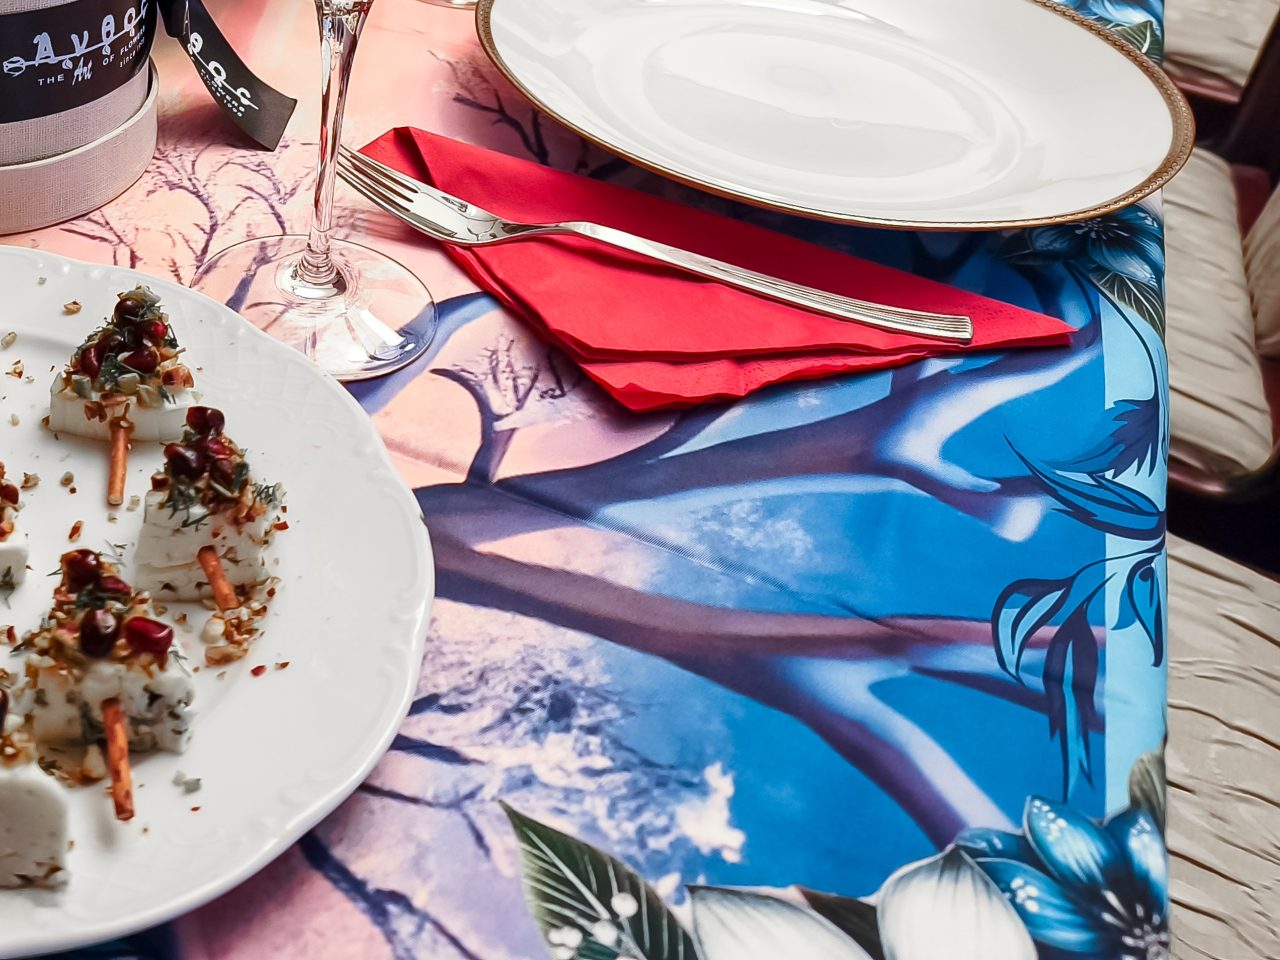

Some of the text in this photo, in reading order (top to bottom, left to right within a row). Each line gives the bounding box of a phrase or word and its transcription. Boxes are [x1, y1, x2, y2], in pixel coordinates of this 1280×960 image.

[37, 73, 65, 86] THE
[71, 56, 93, 86] Art
[101, 53, 115, 66] OF
